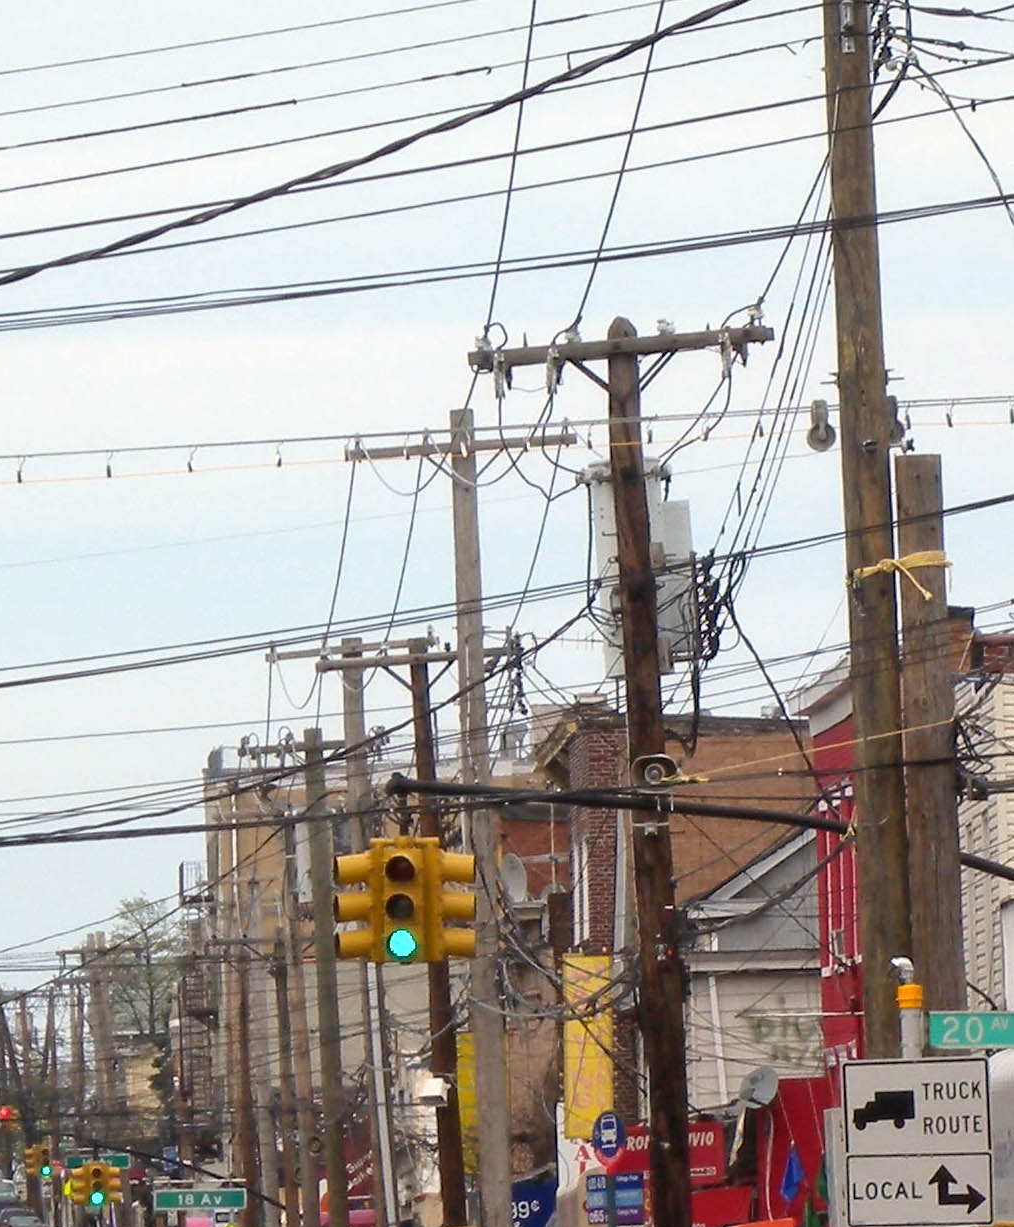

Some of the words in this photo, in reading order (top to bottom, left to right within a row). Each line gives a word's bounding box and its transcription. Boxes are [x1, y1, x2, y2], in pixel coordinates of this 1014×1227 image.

[943, 1016, 984, 1043] 20
[922, 1081, 982, 1101] TRUCK
[923, 1115, 983, 1135] ROUTE
[177, 1195, 194, 1205] 18
[201, 1194, 222, 1205] Av
[853, 1182, 922, 1200] LOCAL
